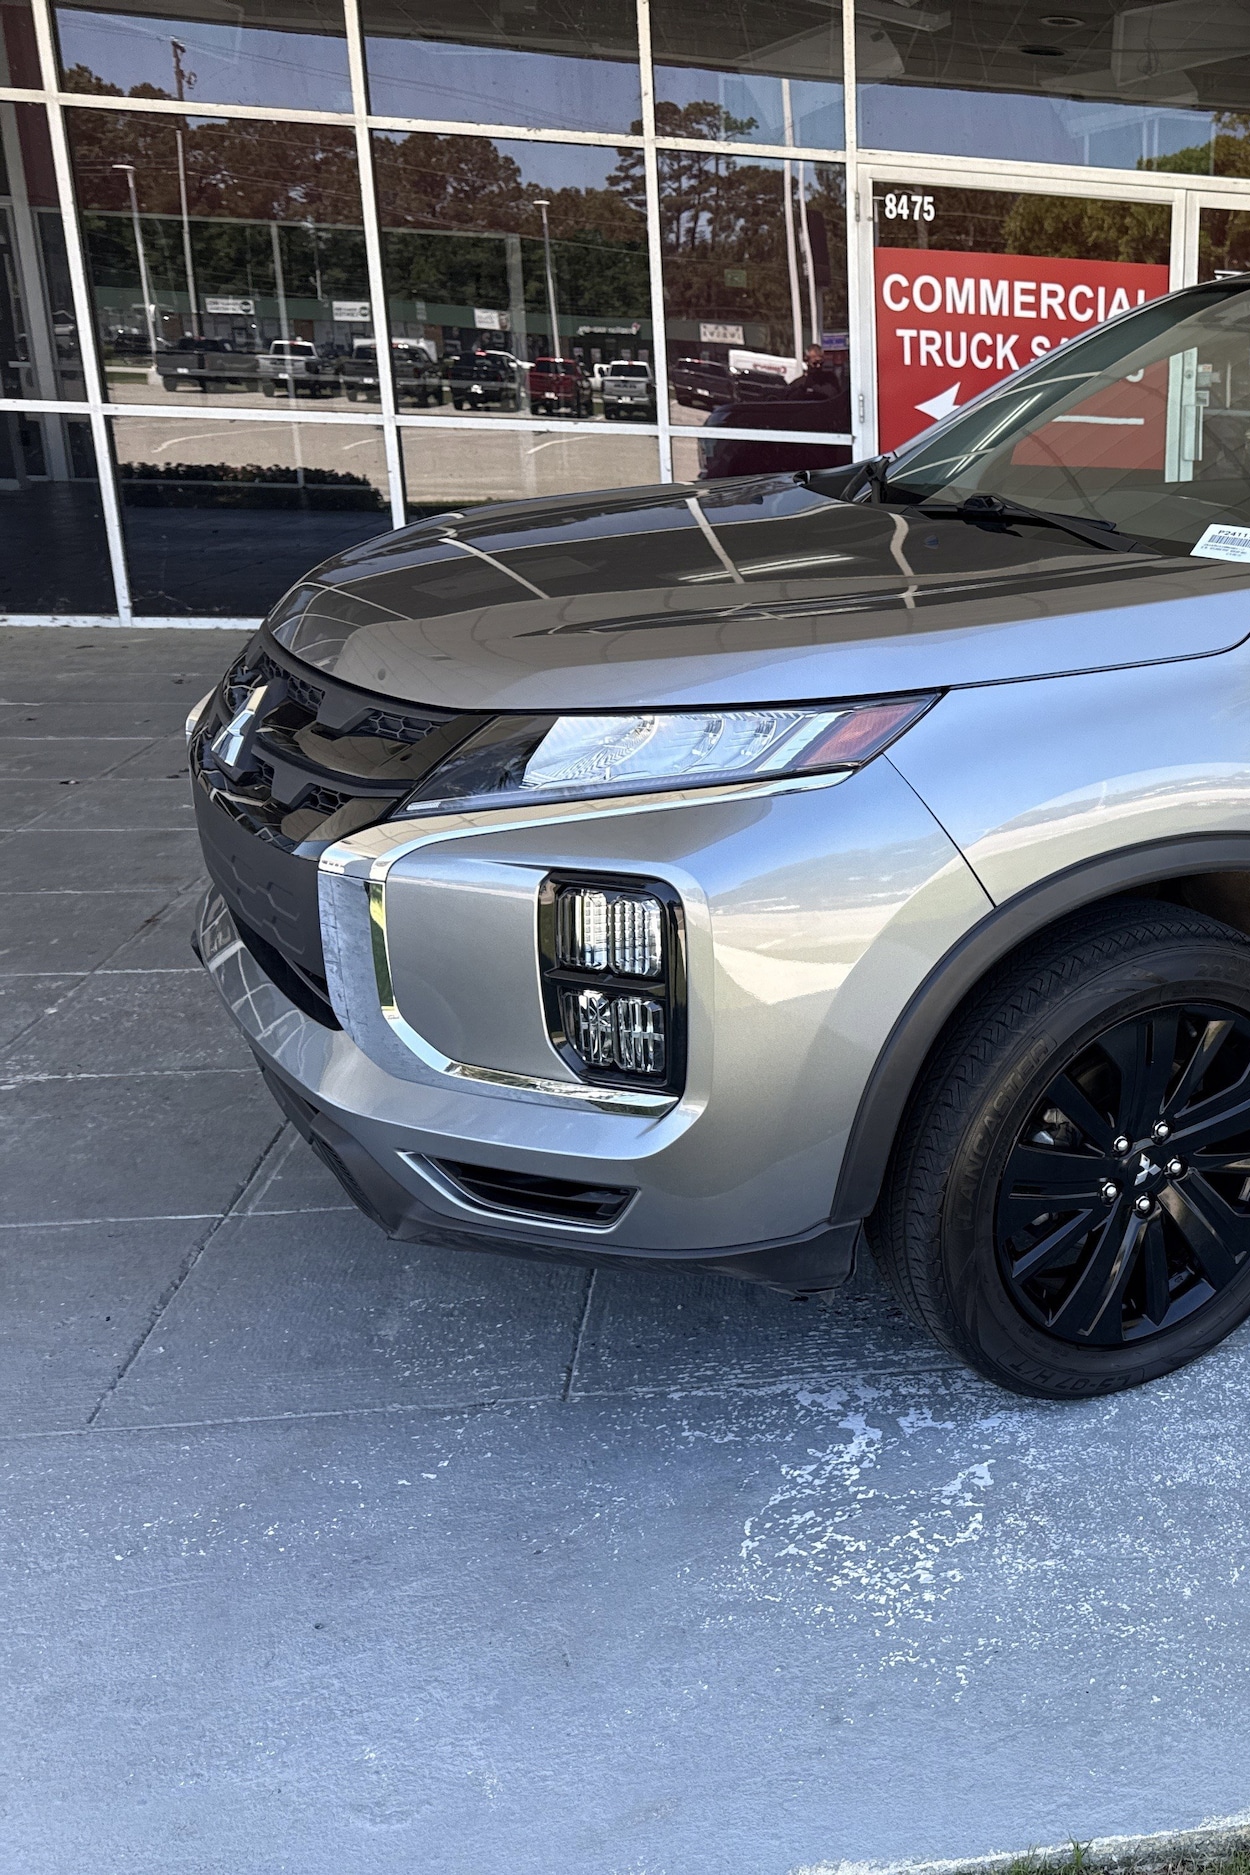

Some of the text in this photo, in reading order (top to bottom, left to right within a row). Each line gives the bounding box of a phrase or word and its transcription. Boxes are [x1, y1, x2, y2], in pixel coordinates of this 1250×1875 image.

[884, 193, 936, 221] 8475
[896, 329, 1020, 371] TRUCK
[958, 1037, 1049, 1221] LANCASTER
[1009, 1359, 1056, 1385] H/T
